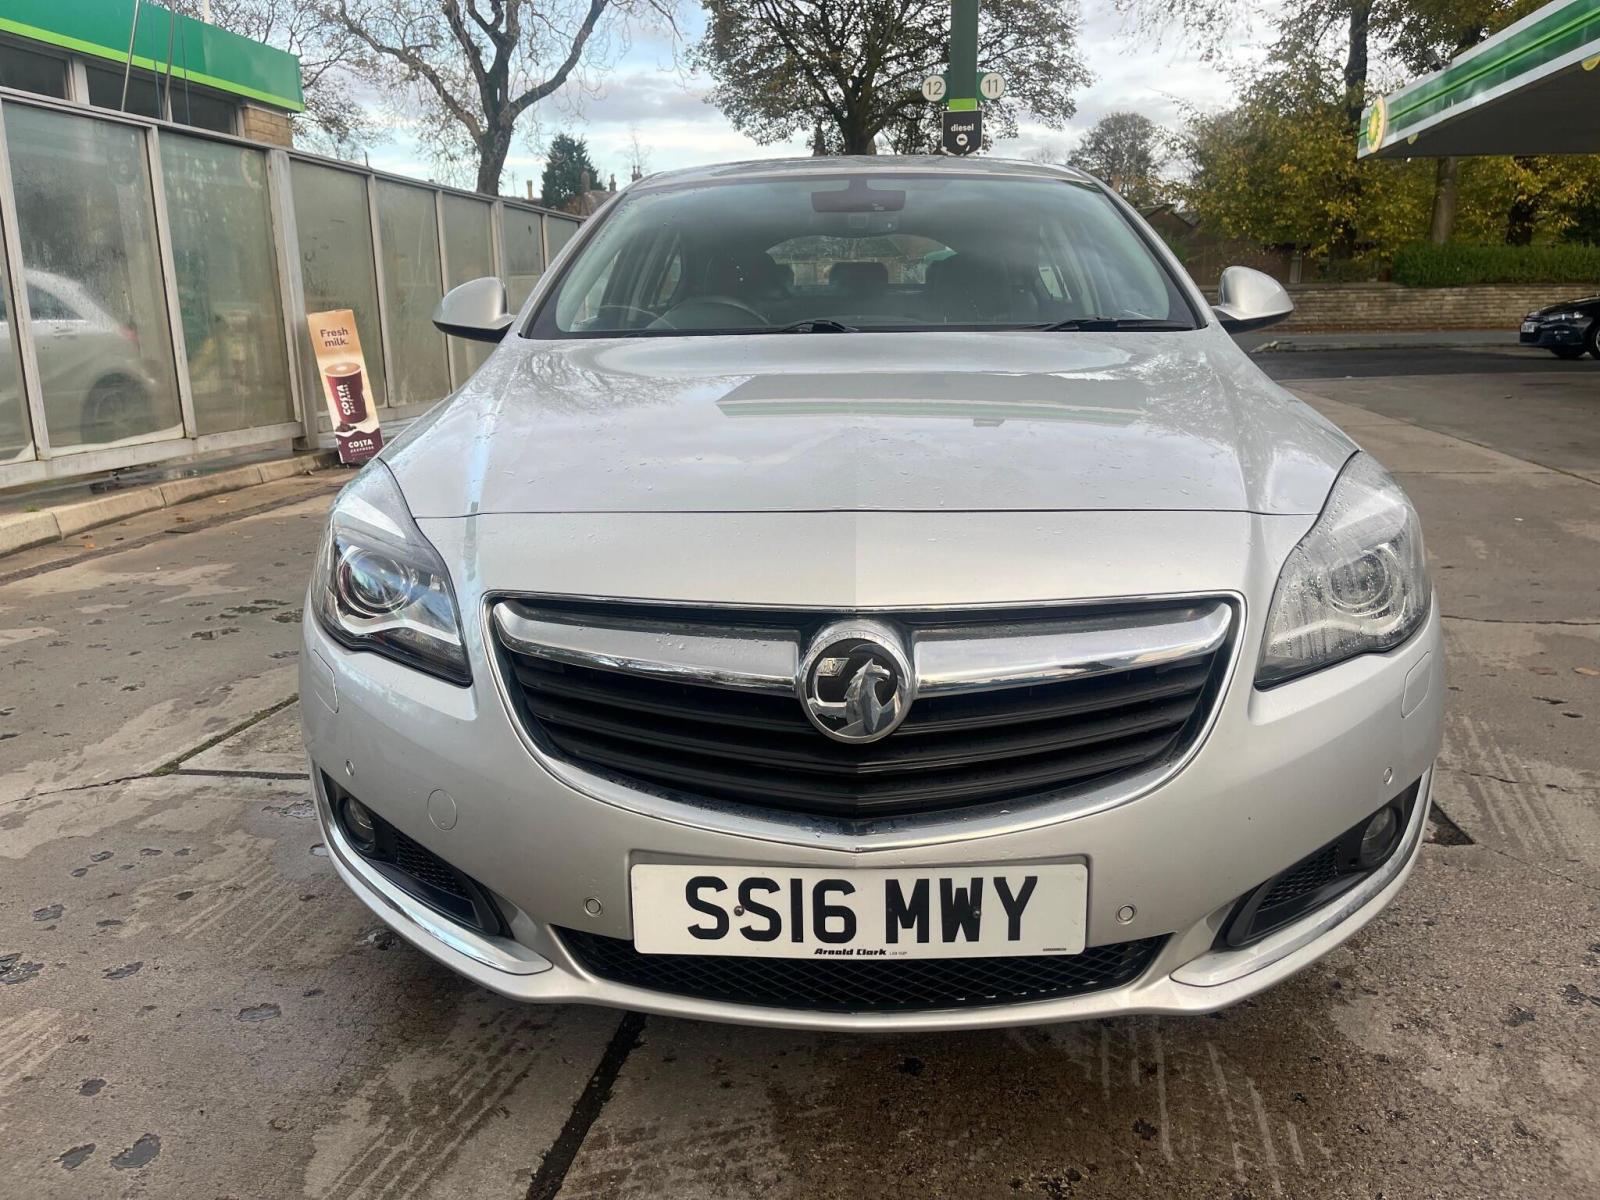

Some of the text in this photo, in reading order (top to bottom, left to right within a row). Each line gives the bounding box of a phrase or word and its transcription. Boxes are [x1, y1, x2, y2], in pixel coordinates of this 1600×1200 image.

[926, 80, 943, 96] 12
[985, 79, 998, 93] 11
[950, 123, 974, 132] diesel
[320, 327, 349, 338] Fresh
[337, 384, 351, 416] COSTA
[348, 438, 374, 449] COSTA
[685, 876, 1038, 943] SS16 MWY
[814, 948, 854, 956] Arnold
[856, 948, 887, 956] Clark
